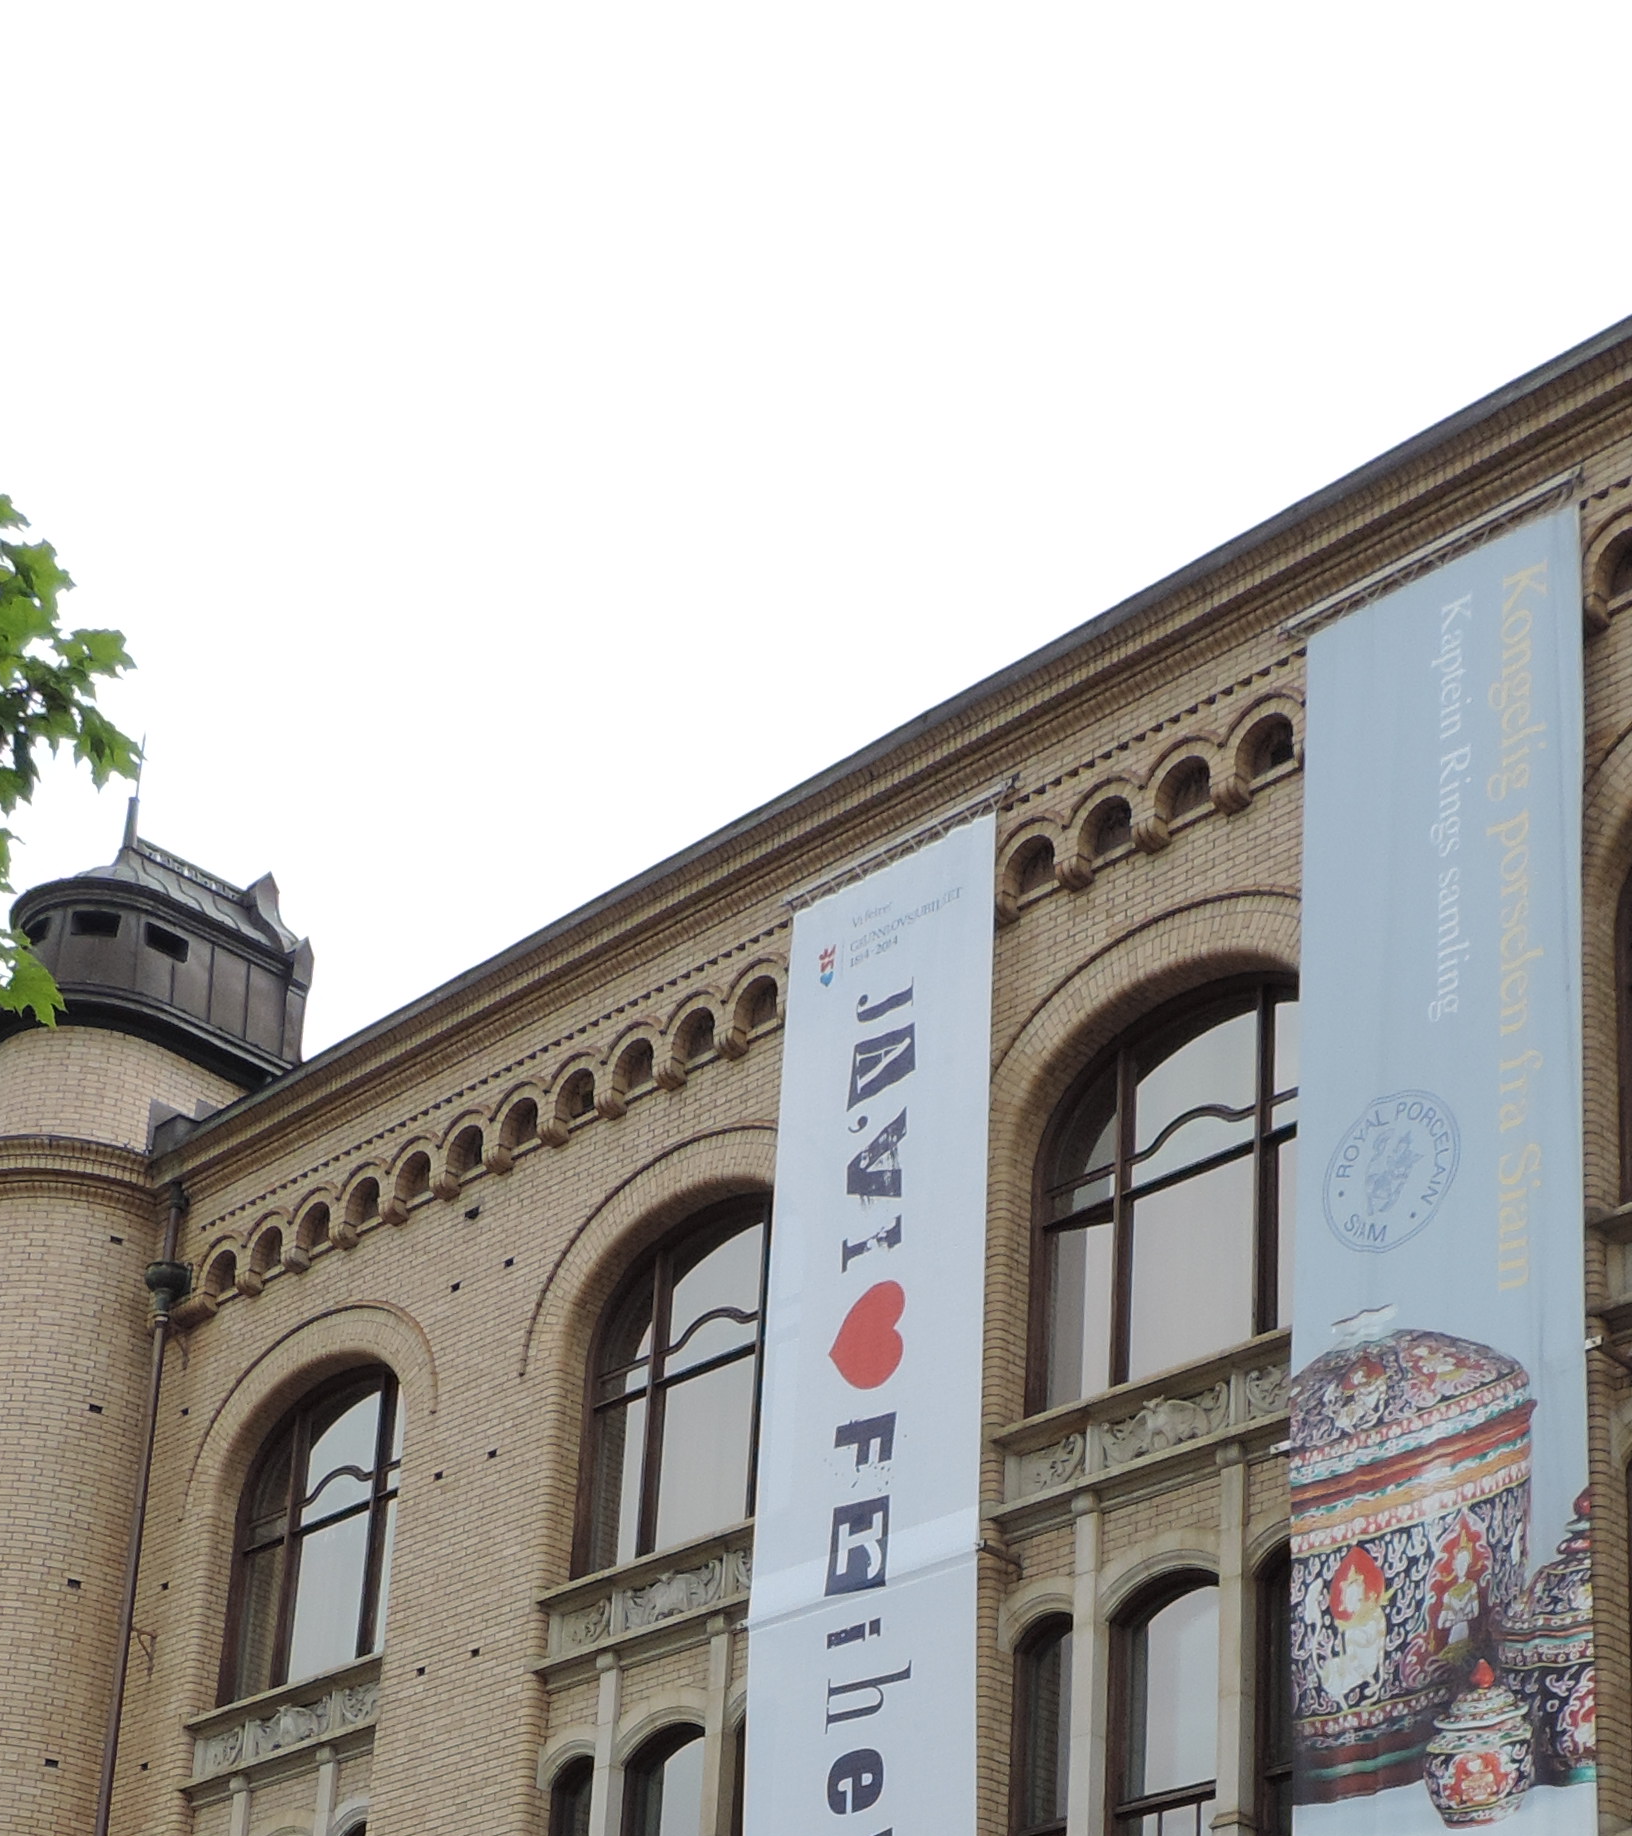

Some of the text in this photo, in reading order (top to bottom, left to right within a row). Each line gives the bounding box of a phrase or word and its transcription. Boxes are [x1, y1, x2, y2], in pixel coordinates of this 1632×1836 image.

[1428, 594, 1472, 1023] Kaptein Rings samling
[1485, 560, 1549, 1291] Kongelig porselen fra Siam
[1336, 1101, 1450, 1205] ROYAL PORCELAIN
[1344, 1213, 1388, 1242] SIAM
